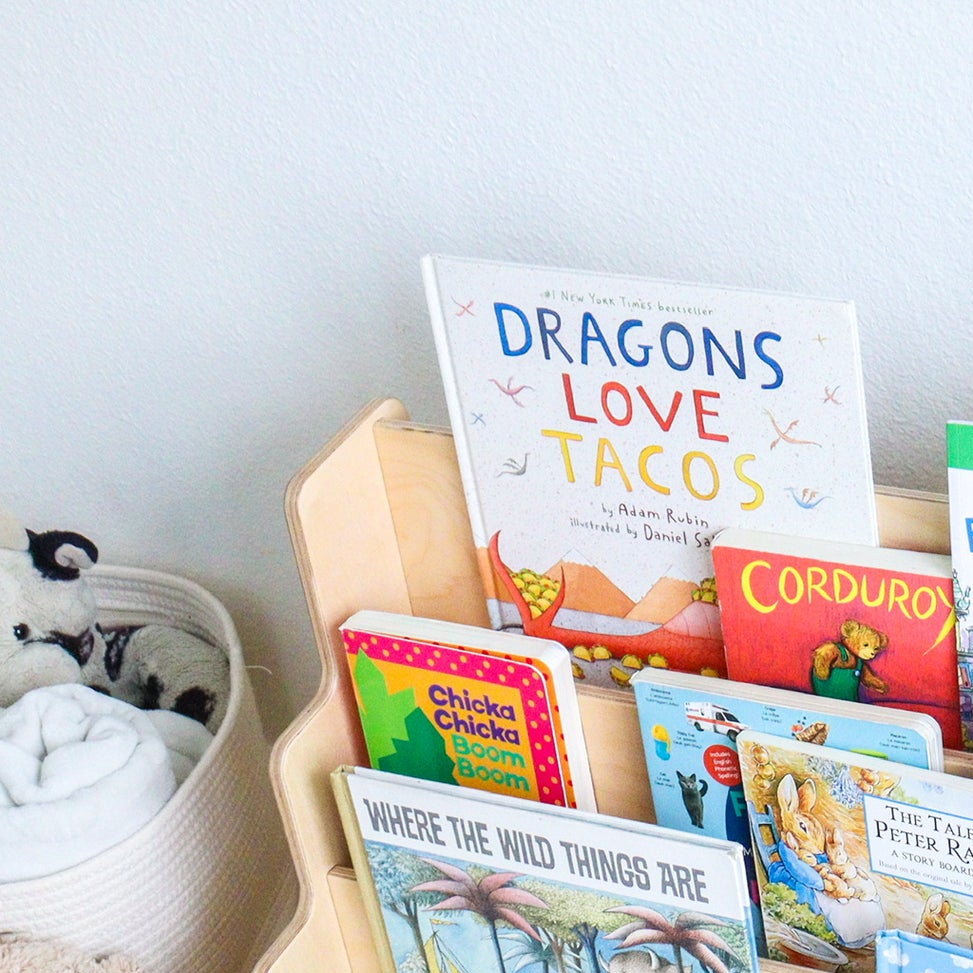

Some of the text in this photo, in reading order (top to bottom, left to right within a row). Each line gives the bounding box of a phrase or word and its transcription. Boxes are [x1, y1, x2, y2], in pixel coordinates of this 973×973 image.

[658, 301, 713, 316] bestseller
[494, 302, 784, 389] DRAGONS
[562, 373, 729, 442] LOVE
[541, 429, 765, 511] TACOS
[570, 518, 688, 545] illustrated by Daniel
[602, 503, 709, 528] by Adam Rubin
[741, 560, 957, 655] CORDUROY
[428, 684, 516, 722] Chicka
[434, 709, 521, 746] Chicka
[451, 735, 526, 769] Boom
[456, 758, 531, 792] Boom
[885, 805, 924, 828] THE
[363, 798, 709, 904] WHERE THE WILD THINGS ARE
[874, 819, 940, 853] PETER
[879, 860, 898, 871] Based
[910, 867, 922, 877] the
[923, 872, 949, 884] original
[950, 879, 963, 887] tale
[964, 882, 973, 891] by
[891, 850, 899, 858] A
[902, 852, 935, 867] STORY
